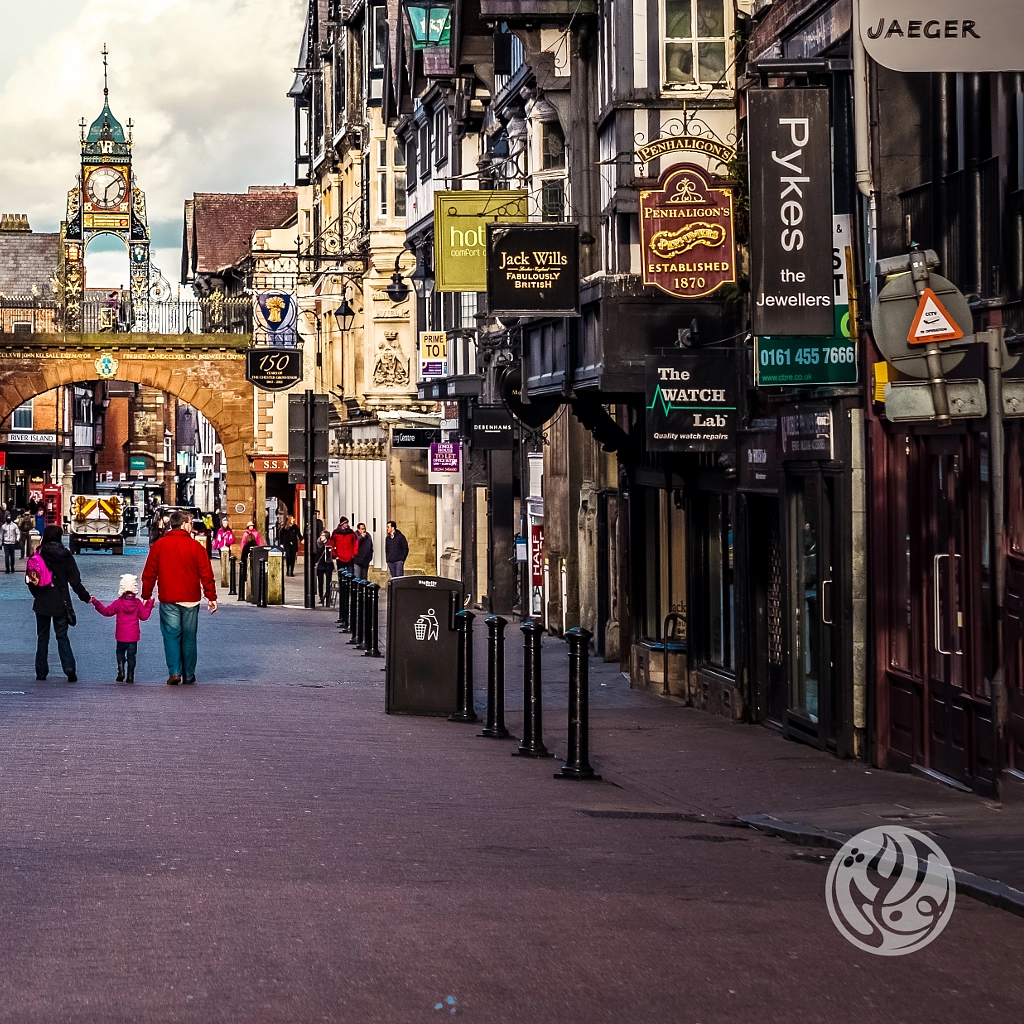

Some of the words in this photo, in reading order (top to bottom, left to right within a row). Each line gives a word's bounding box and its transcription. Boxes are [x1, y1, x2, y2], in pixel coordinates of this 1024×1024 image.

[866, 17, 982, 40] JAEGER
[99, 140, 113, 154] VR
[641, 139, 731, 161] PENHALIGON'S
[771, 117, 811, 252] Pykes
[644, 206, 730, 219] PENHALIGON'S
[450, 249, 480, 257] comfort
[499, 251, 530, 270] Jack
[532, 251, 569, 266] Wills
[648, 262, 730, 273] ESTABLISHED
[506, 272, 561, 280] FABULOUSLY
[780, 268, 806, 283] the
[514, 280, 553, 289] BRITISH
[674, 277, 706, 289] 1870
[756, 292, 831, 307] Jewellers
[423, 335, 444, 343] PRIME
[426, 344, 440, 357] TO
[760, 348, 791, 366] 0161
[795, 347, 820, 365] 455
[822, 346, 855, 364] 7666
[259, 352, 290, 372] 150
[657, 367, 691, 381] The
[761, 373, 812, 382] www.cbre.co.uk
[661, 388, 726, 402] WATCH
[692, 413, 726, 427] Lab
[653, 432, 679, 441] Quality
[702, 433, 729, 441] repairs
[263, 460, 281, 469] S.S.
[532, 534, 540, 576] HALF
